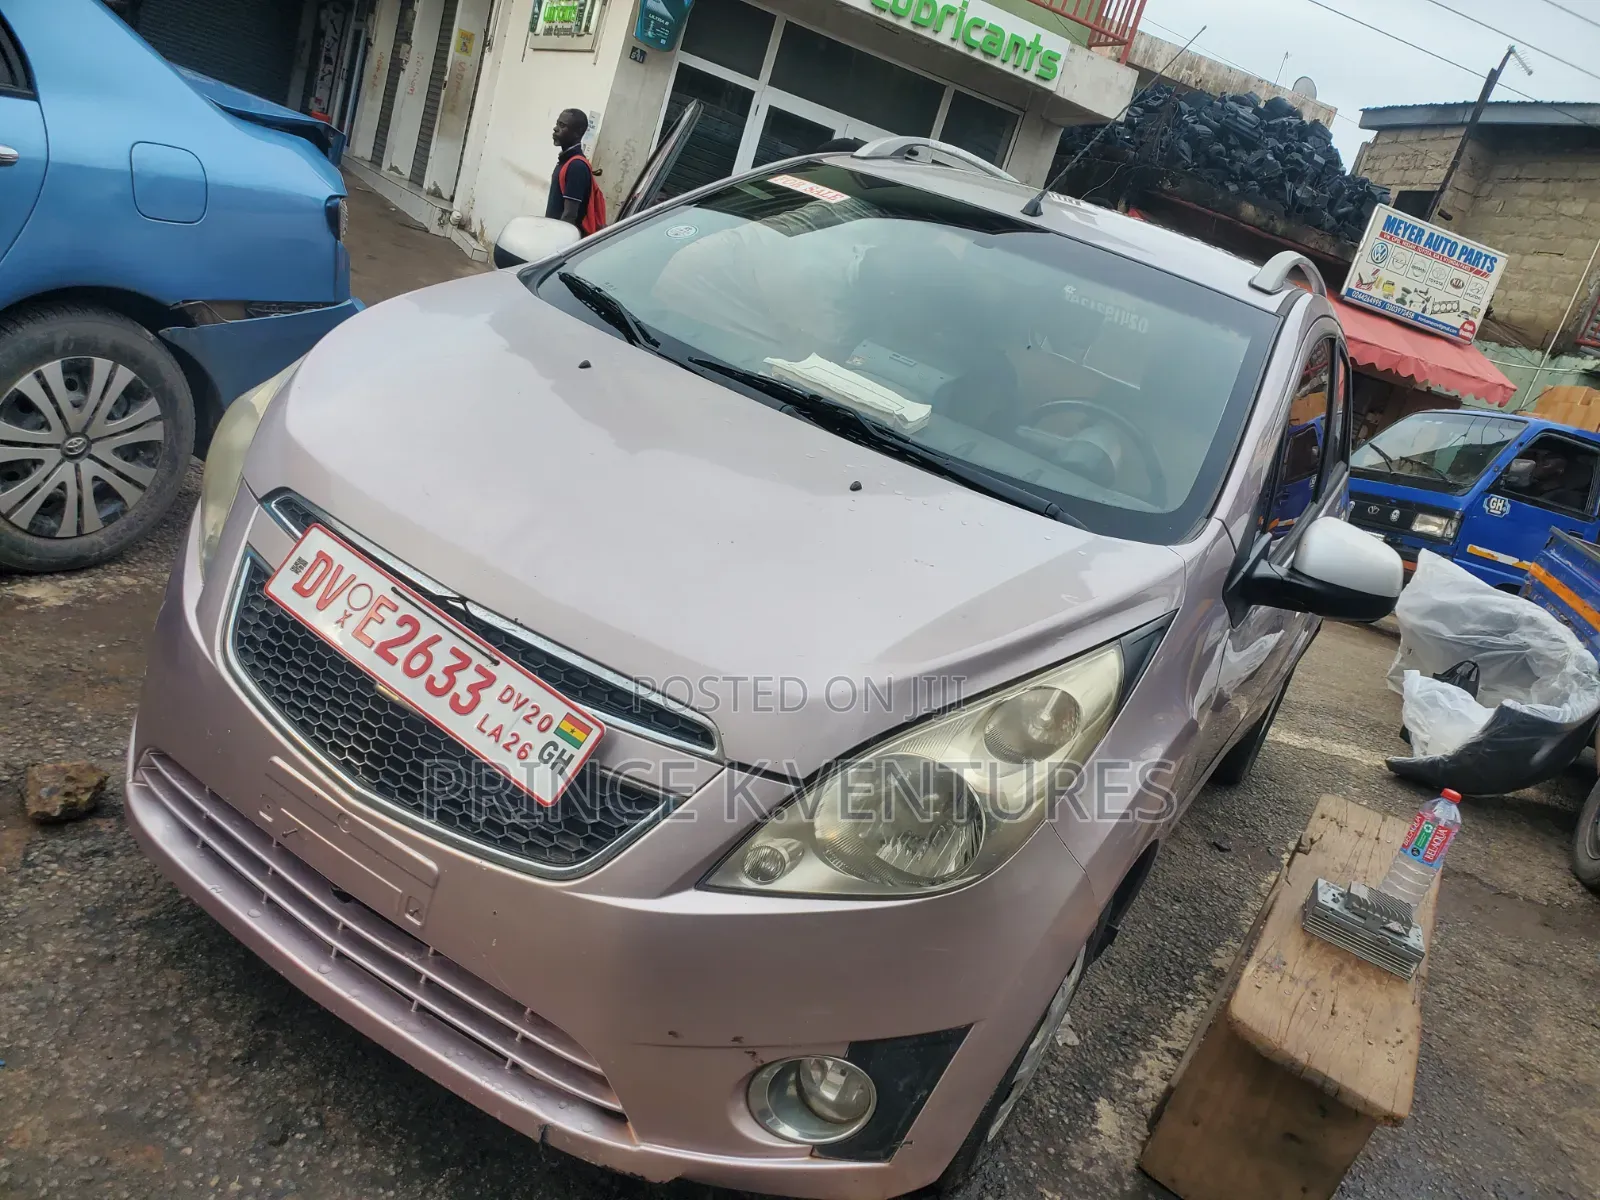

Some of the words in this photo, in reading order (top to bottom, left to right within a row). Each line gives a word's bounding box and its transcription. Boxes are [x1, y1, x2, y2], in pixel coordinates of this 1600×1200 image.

[1382, 214, 1425, 245] MEYER
[1423, 231, 1458, 258] AUTO
[1457, 244, 1498, 274] PARTS
[1489, 497, 1505, 511] GH
[291, 550, 357, 611] DV
[351, 594, 497, 716] E2633
[537, 740, 575, 776] GH
